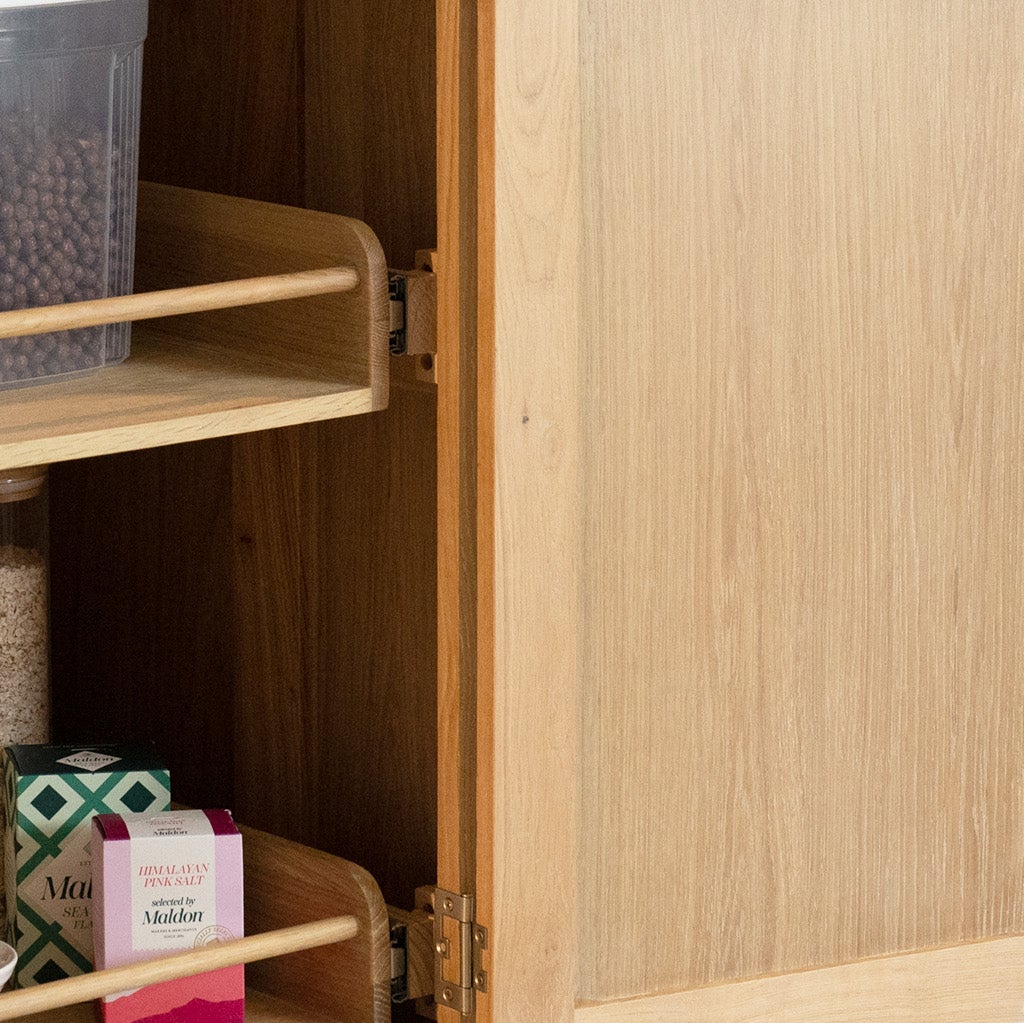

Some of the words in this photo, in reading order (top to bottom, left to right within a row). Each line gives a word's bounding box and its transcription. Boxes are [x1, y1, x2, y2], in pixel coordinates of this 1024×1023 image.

[139, 863, 209, 876] HIMALAYAN
[40, 872, 92, 900] Mal
[144, 876, 172, 888] PINK
[174, 875, 204, 886] SALT
[151, 897, 184, 907] selected
[185, 896, 196, 908] by
[142, 907, 204, 925] Maldon
[73, 920, 93, 930] FLA
